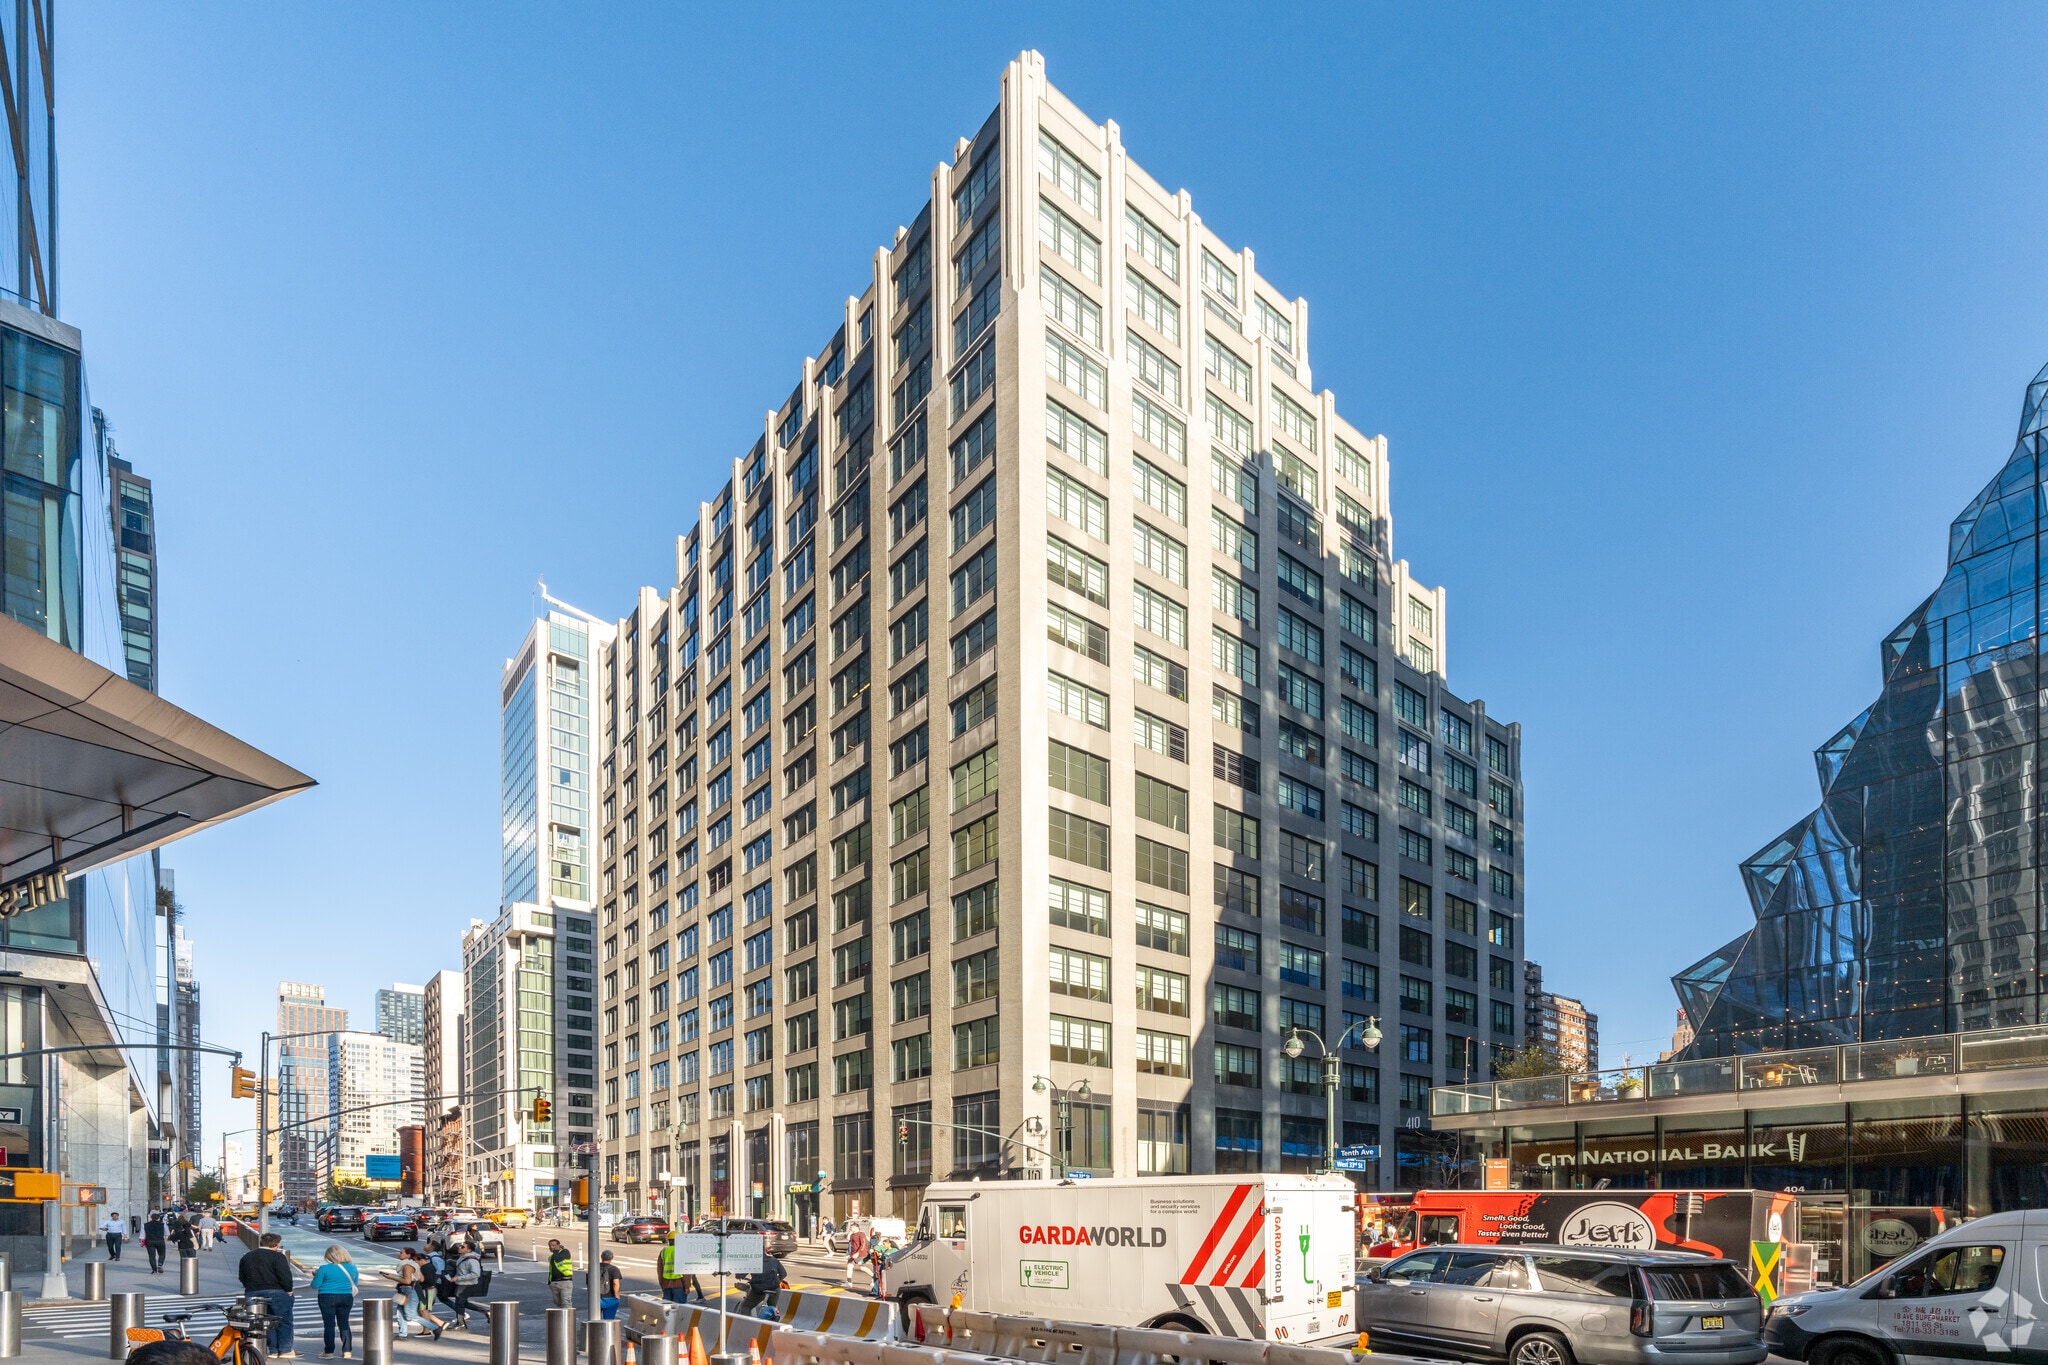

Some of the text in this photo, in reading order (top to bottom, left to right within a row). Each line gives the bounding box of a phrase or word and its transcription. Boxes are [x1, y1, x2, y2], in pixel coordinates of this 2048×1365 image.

[1406, 1116, 1420, 1129] 410
[1537, 1142, 1776, 1167] CITY NATIONAL BANK
[1019, 1225, 1167, 1248] GARDAWORLD
[1568, 1218, 1644, 1244] Jerk
[1274, 1216, 1282, 1294] GARDAWORLD
